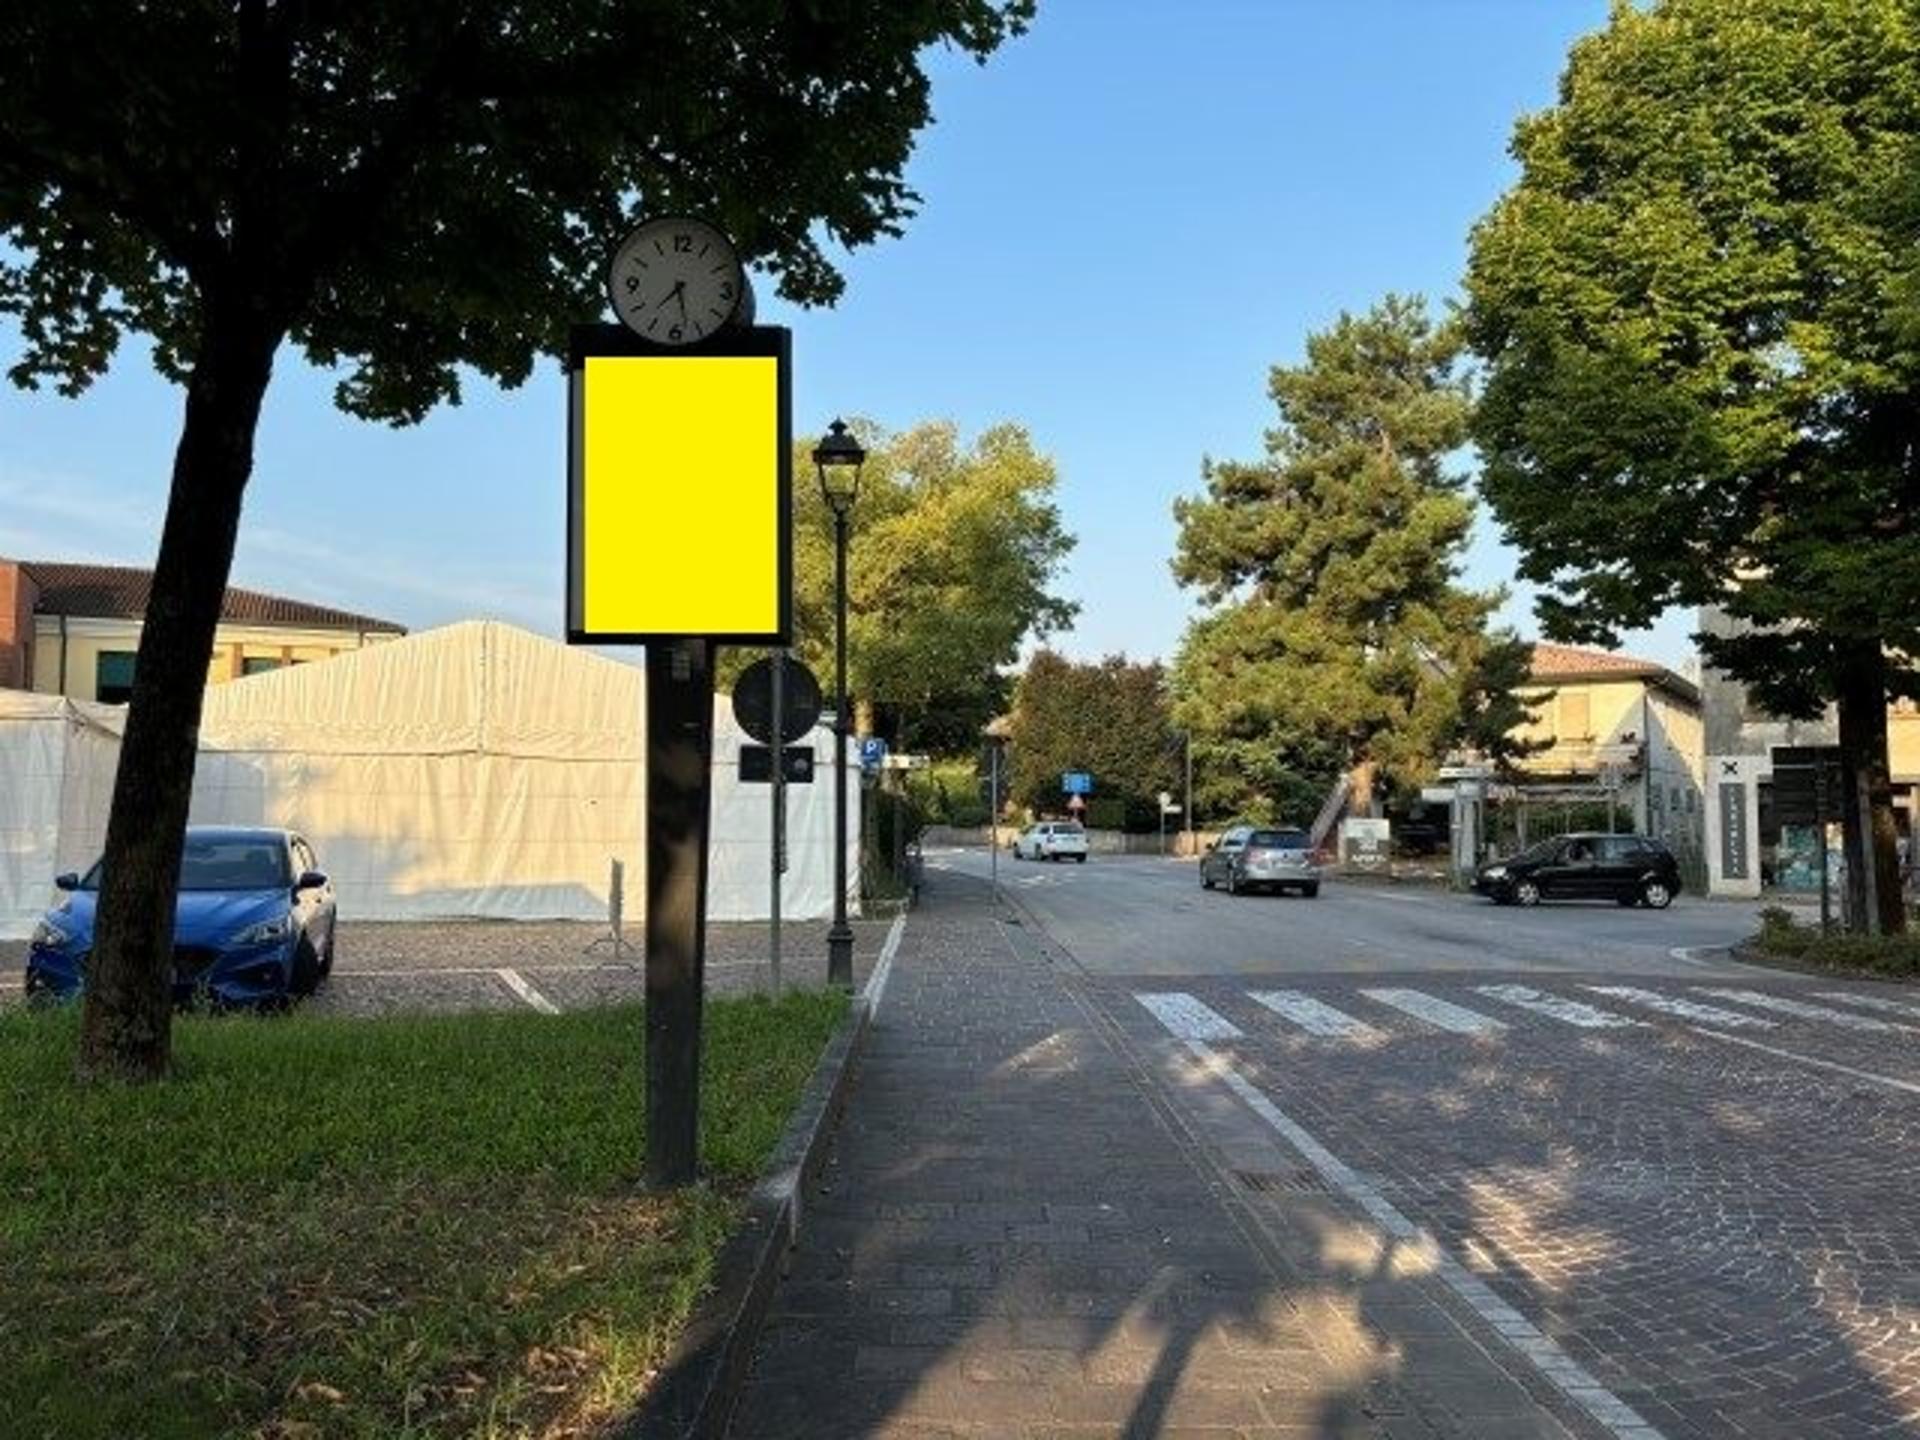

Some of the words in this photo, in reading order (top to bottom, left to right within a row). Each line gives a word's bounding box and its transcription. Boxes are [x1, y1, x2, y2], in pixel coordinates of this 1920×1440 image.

[674, 236, 692, 253] 12
[626, 276, 640, 294] 9
[719, 282, 733, 300] 3
[668, 324, 682, 340] 6
[866, 740, 877, 754] P
